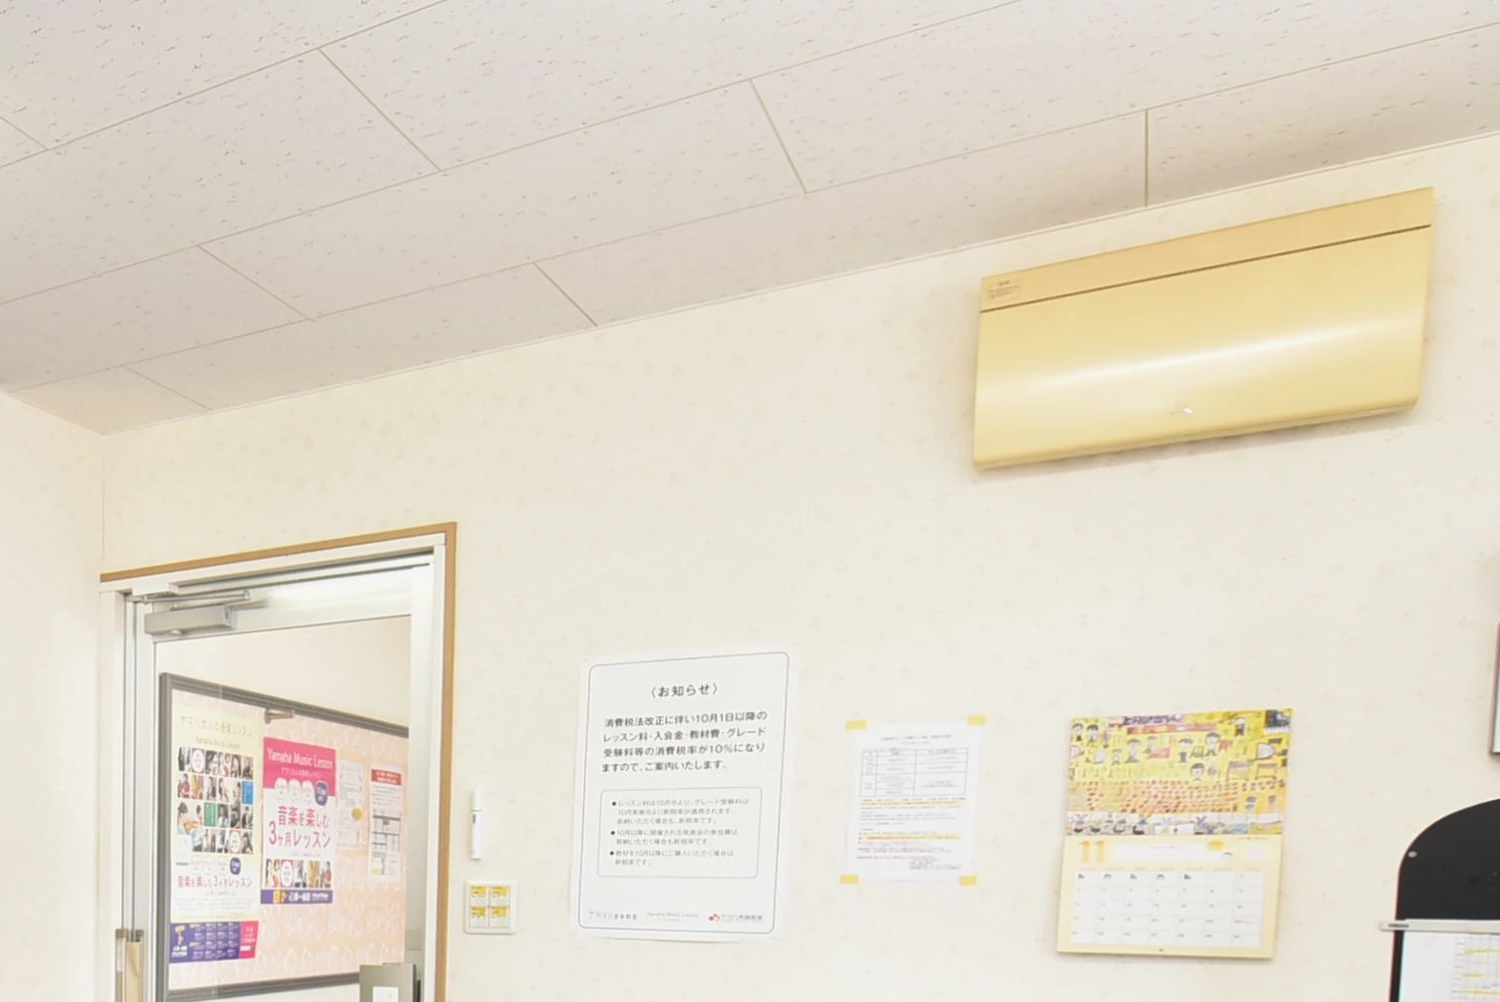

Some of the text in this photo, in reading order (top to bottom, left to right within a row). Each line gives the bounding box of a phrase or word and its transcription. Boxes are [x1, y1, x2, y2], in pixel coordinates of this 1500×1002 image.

[604, 711, 768, 728] 消費税法改正に伴い10月1日以降の
[267, 747, 292, 764] Yamaha
[293, 751, 312, 767] Music
[278, 805, 330, 828] 音楽を楽しむ
